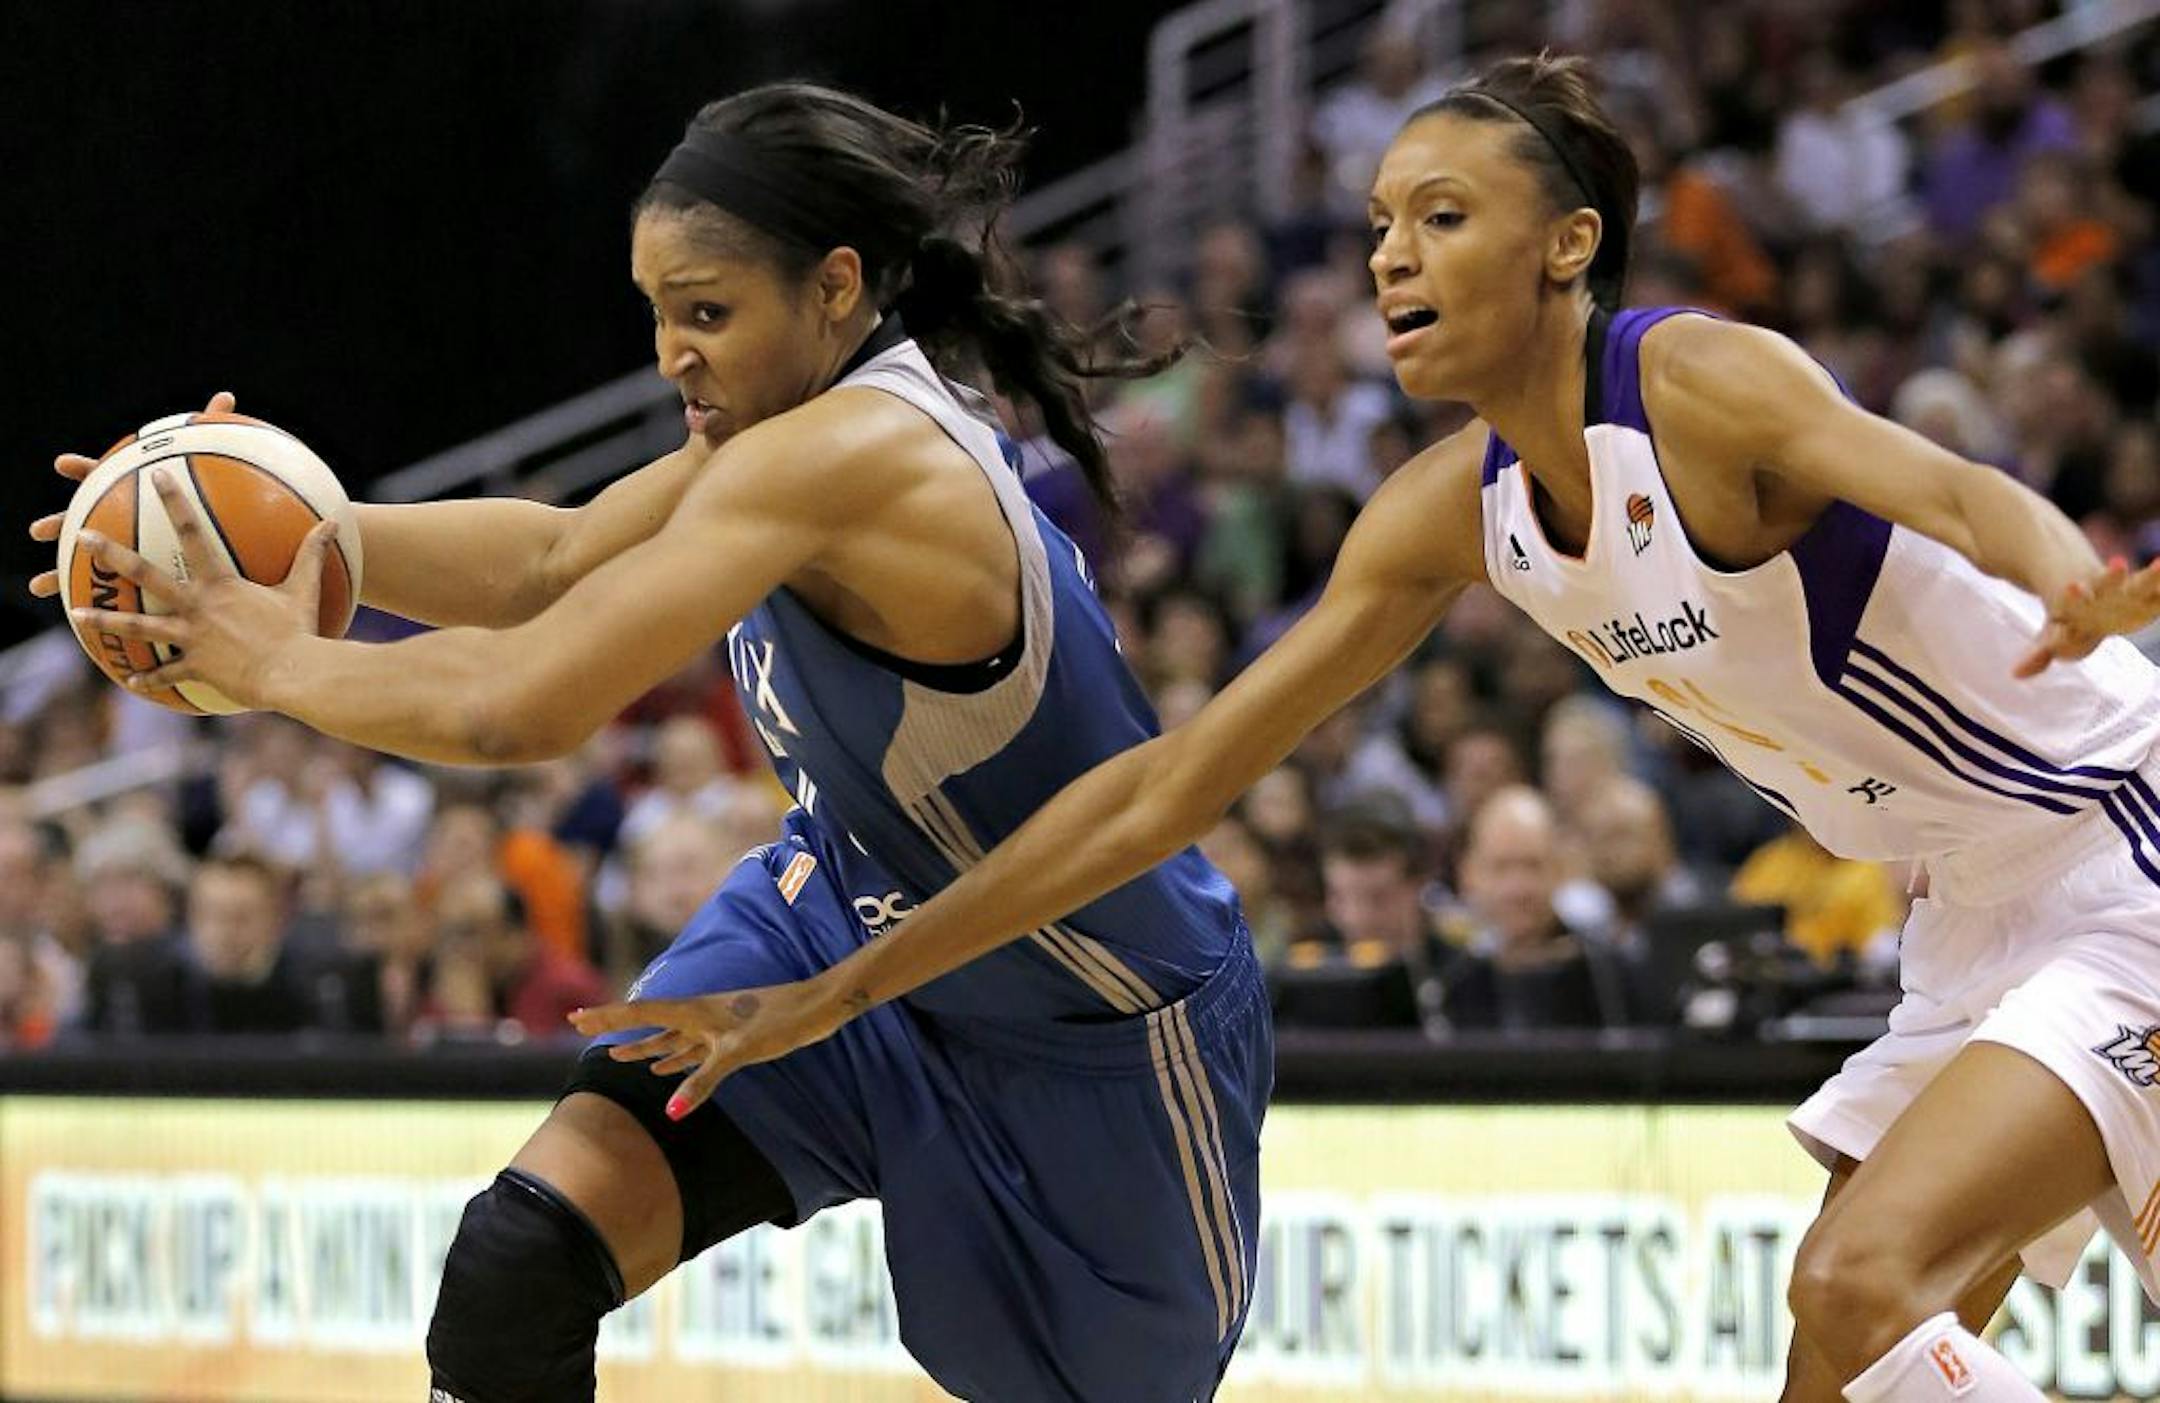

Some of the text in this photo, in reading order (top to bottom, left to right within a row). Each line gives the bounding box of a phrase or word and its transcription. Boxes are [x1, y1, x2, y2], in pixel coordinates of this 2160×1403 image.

[1588, 601, 1720, 663] LifeLock
[1382, 1216, 1682, 1366] TICKETS
[1703, 1226, 1780, 1370] AT
